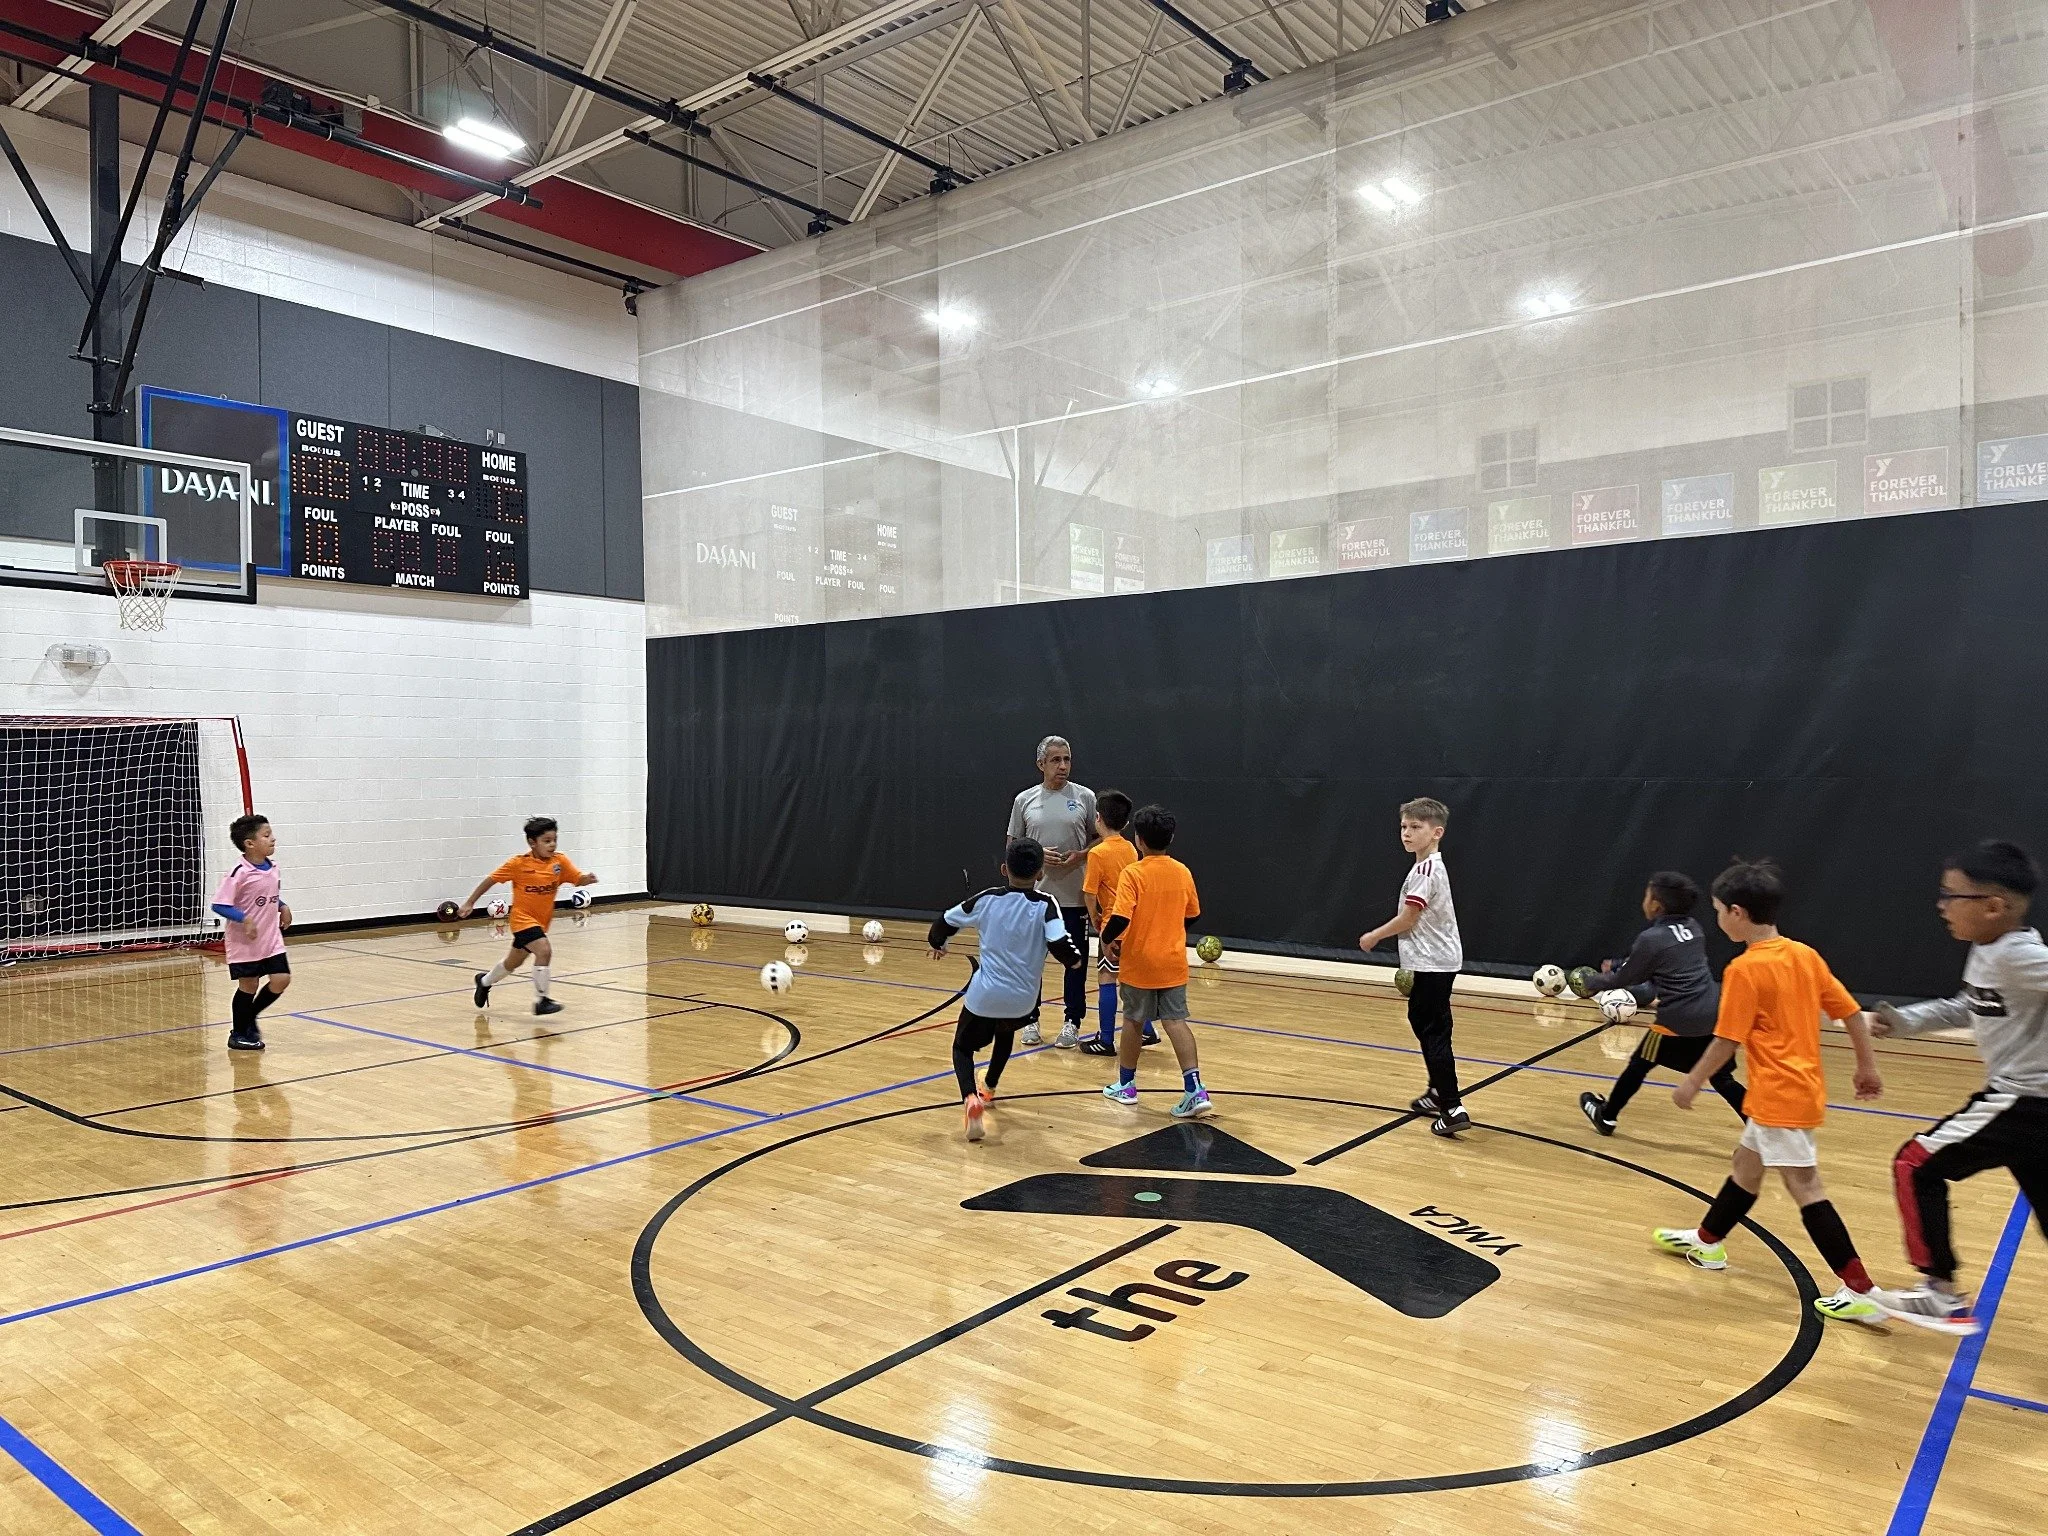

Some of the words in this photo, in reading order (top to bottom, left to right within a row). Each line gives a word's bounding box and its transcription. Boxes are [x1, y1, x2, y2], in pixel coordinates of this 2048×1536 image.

[296, 419, 345, 443] GUEST
[481, 451, 516, 472] HOME
[1984, 462, 2048, 479] FOREVE
[362, 476, 368, 485] 1
[374, 477, 382, 487] 2
[1870, 474, 1938, 491] FOREVER
[1983, 475, 2047, 490] THANKF
[400, 481, 430, 499] TIME
[447, 489, 455, 498] 3
[458, 490, 466, 499] 4
[1765, 486, 1827, 503] FOREVER
[1870, 485, 1948, 502] THANKFUL
[401, 501, 430, 519] POSS
[771, 504, 798, 521] GUEST
[1667, 498, 1725, 513] FOREVER
[1765, 497, 1836, 514] THANKFUL
[304, 506, 338, 522] FOUL
[1577, 509, 1631, 523] FOREVER
[1668, 508, 1732, 523] THANKFUL
[374, 516, 420, 533] PLAYER
[431, 523, 462, 538] FOUL
[877, 523, 897, 539] HOME
[1493, 519, 1544, 533] FOREVER
[1577, 519, 1638, 534] THANKFUL
[485, 530, 514, 544] FOUL
[1415, 529, 1462, 542] FOREVER
[1493, 528, 1550, 542] THANKFUL
[1341, 538, 1385, 551] FOREVER
[1415, 538, 1468, 552] THANKFUL
[696, 542, 756, 570] DASANI
[830, 549, 847, 561] TIME
[1209, 555, 1248, 565] FOREVER
[1273, 547, 1314, 558] FOREVER
[1341, 546, 1391, 560] THANKFUL
[1210, 563, 1253, 574] THANKFUL
[1273, 556, 1320, 567] THANKFUL
[301, 563, 346, 579] POINTS
[776, 570, 796, 582] FOUL
[829, 563, 847, 576] POSS
[395, 573, 435, 588] MATCH
[815, 576, 841, 587] PLAYER
[847, 580, 866, 591] FOUL
[483, 581, 520, 596] POINTS
[879, 584, 896, 594] FOUL
[774, 613, 800, 624] POINTS
[525, 882, 556, 895] cape
[1667, 924, 1694, 943] 16
[1409, 1205, 1523, 1256] YMCA
[1040, 1258, 1250, 1342] the
